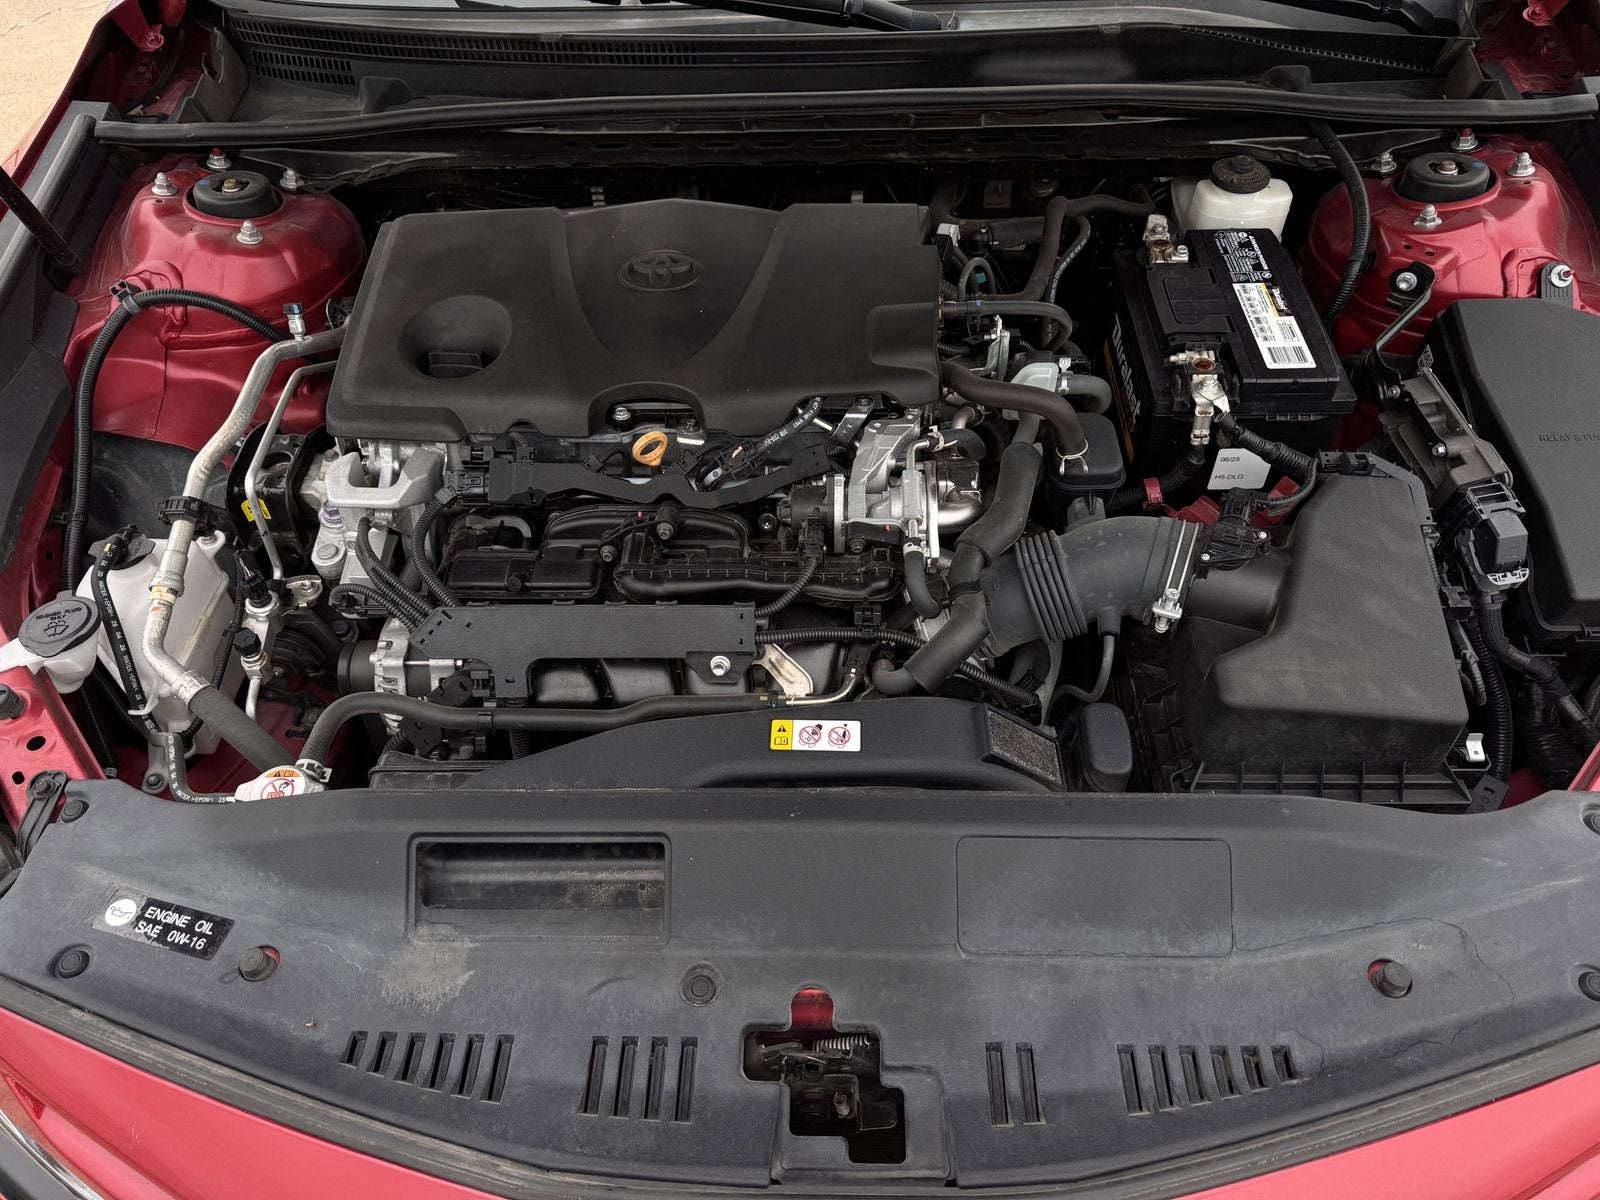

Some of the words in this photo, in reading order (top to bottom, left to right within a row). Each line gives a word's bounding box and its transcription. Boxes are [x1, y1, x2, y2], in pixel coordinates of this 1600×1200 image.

[1112, 312, 1142, 425] Duralast
[1538, 433, 1571, 441] RELAY
[64, 606, 82, 614] FLUID
[98, 580, 108, 597] WATER
[115, 631, 122, 639] 04
[119, 643, 127, 652] 20
[123, 654, 132, 673] WATER
[175, 789, 191, 801] WATER
[144, 906, 191, 928] ENGINE
[194, 920, 214, 935] OIL
[135, 921, 162, 938] SAE
[167, 930, 206, 950] 0W-16
